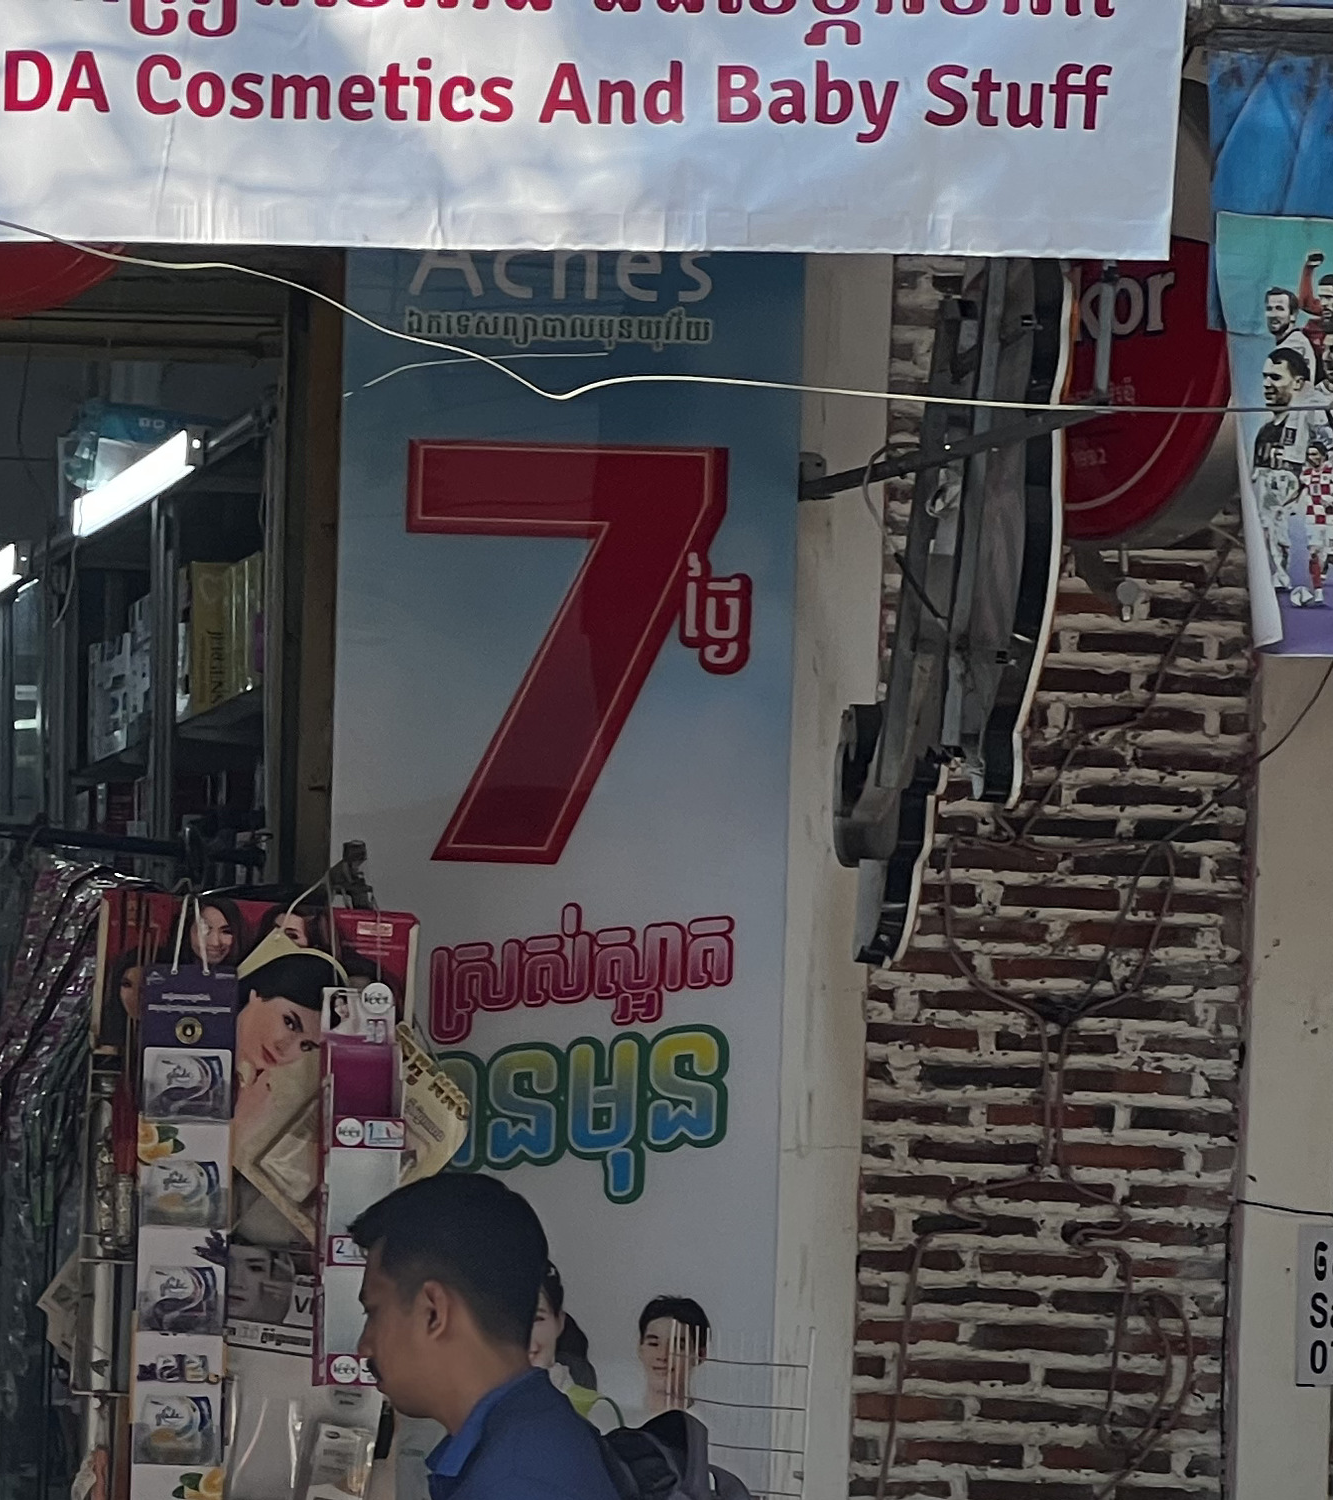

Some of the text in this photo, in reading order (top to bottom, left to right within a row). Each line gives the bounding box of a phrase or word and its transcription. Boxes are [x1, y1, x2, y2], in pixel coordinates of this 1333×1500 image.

[136, 52, 513, 124] Cosmetics
[539, 61, 685, 125] And
[718, 63, 899, 143] Baby
[925, 63, 1112, 132] Stuff
[409, 249, 713, 303] Acnes
[406, 439, 729, 864] 7
[336, 1240, 345, 1254] 2
[1314, 1241, 1333, 1281] G
[1310, 1340, 1333, 1374] 0
